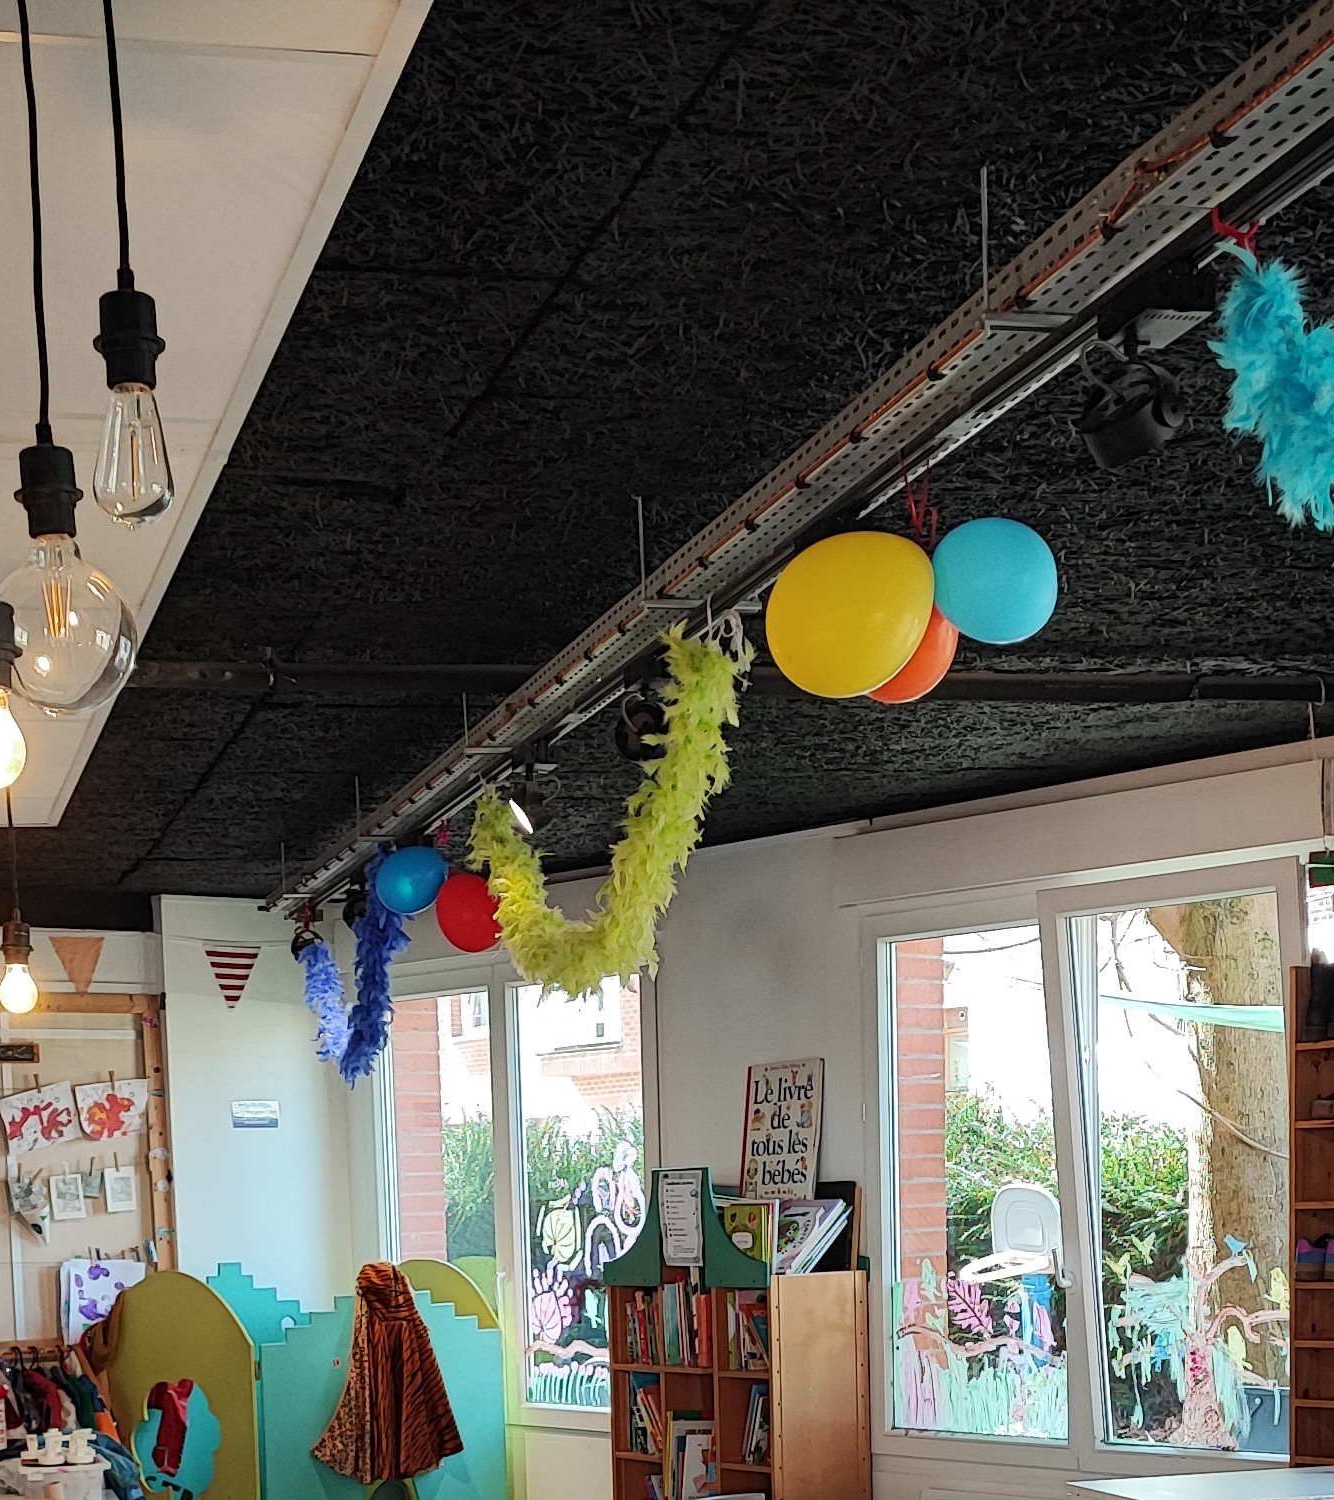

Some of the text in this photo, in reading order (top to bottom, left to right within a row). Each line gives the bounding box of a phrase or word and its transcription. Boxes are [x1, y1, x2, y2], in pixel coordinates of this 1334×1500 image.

[753, 1077, 814, 1105] Le livre
[770, 1104, 790, 1130] de
[751, 1129, 808, 1157] tous les
[761, 1158, 807, 1186] bébés
